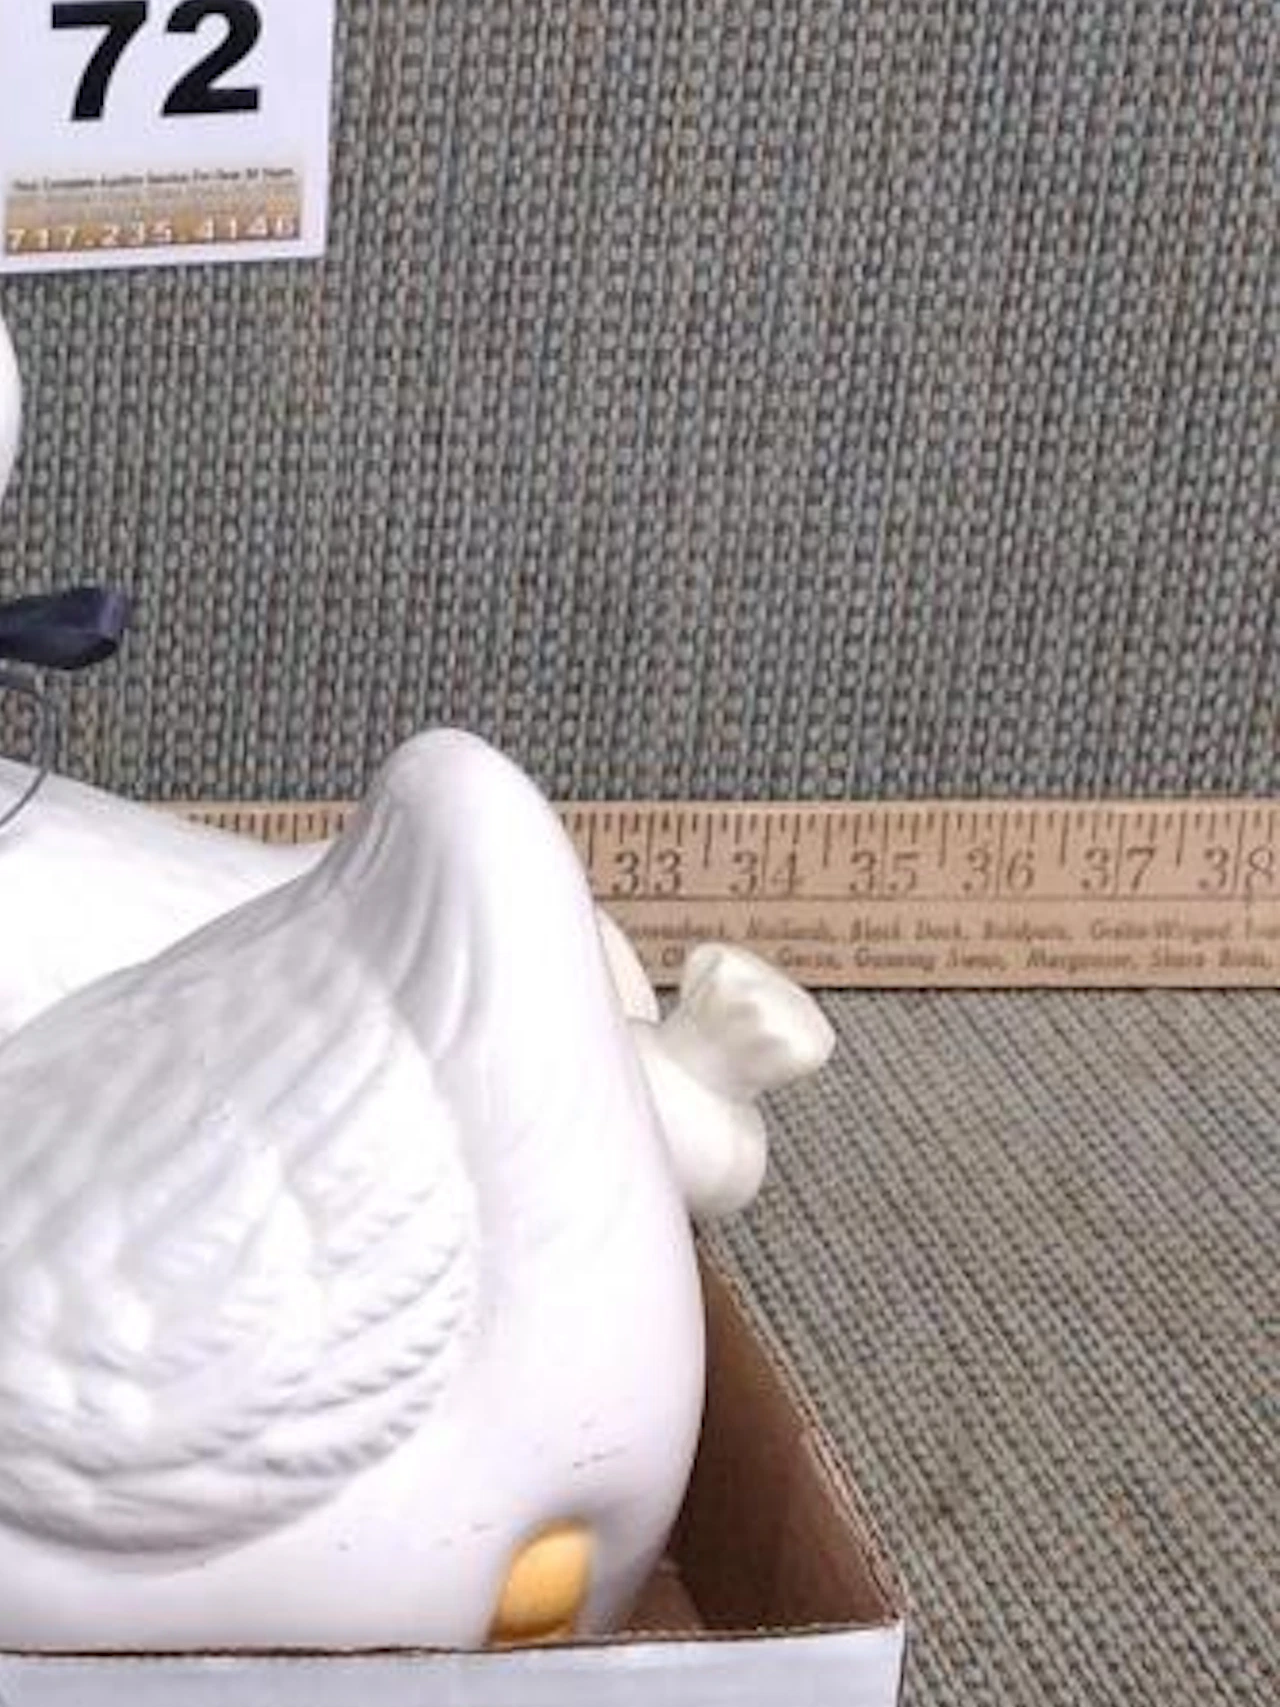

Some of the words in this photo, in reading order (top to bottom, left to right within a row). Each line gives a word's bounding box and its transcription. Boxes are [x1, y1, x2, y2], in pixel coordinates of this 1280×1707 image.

[610, 849, 684, 896] 33
[728, 849, 803, 895] 34
[848, 849, 920, 894] 35
[962, 848, 1037, 894] 36
[1080, 847, 1156, 893] 37
[1199, 847, 1277, 892] 38
